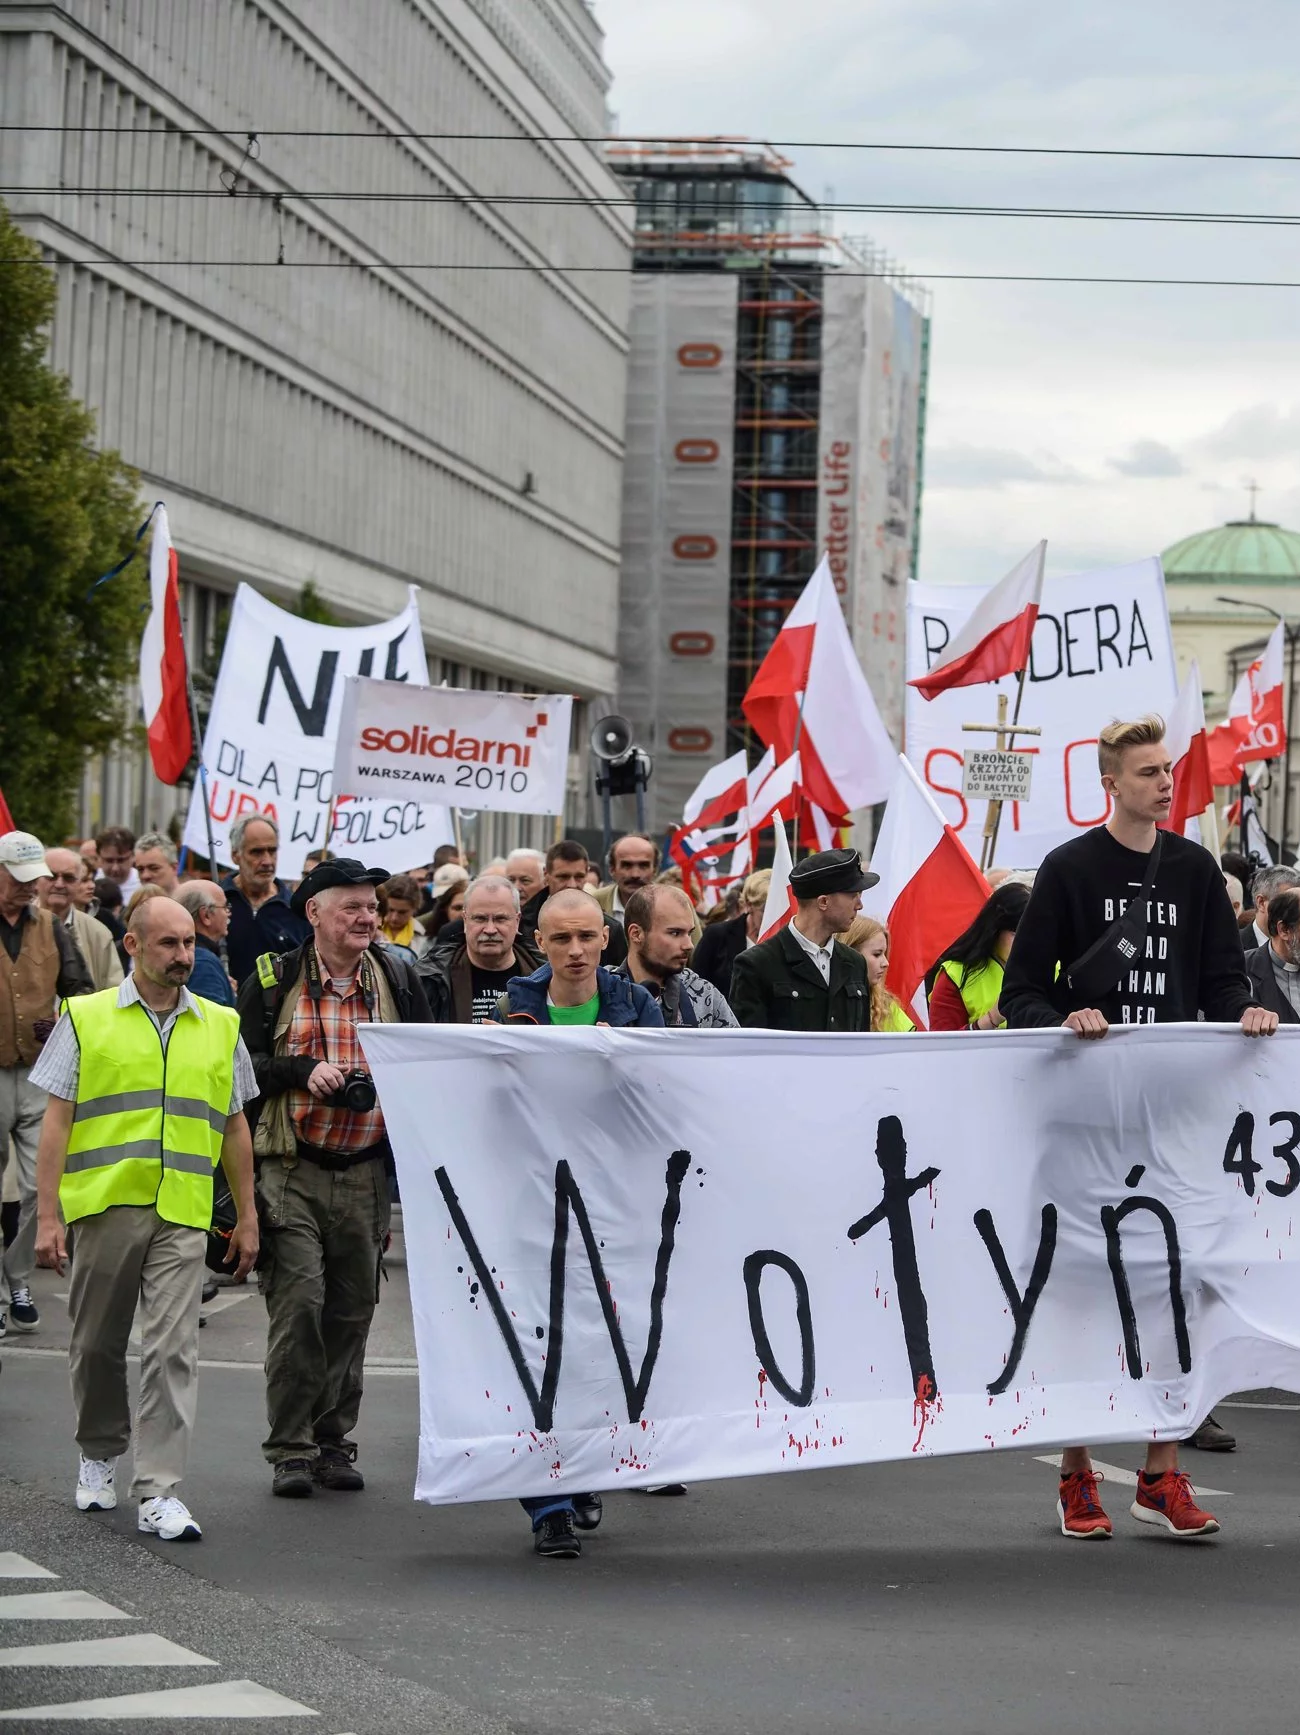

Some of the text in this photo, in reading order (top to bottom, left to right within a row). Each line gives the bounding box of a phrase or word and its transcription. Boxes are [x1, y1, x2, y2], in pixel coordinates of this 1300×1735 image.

[824, 440, 851, 597] Better Life
[923, 600, 1153, 684] BDERA
[360, 724, 537, 768] solidarni
[217, 740, 282, 796] DLA
[357, 764, 529, 793] WARSZAWA 2010
[924, 738, 1113, 832] STO
[967, 782, 980, 791] DO
[1016, 766, 1030, 775] OD
[290, 810, 321, 843] W
[328, 801, 427, 844] POLSCE
[1104, 898, 1177, 926] BETER
[482, 989, 490, 997] 11
